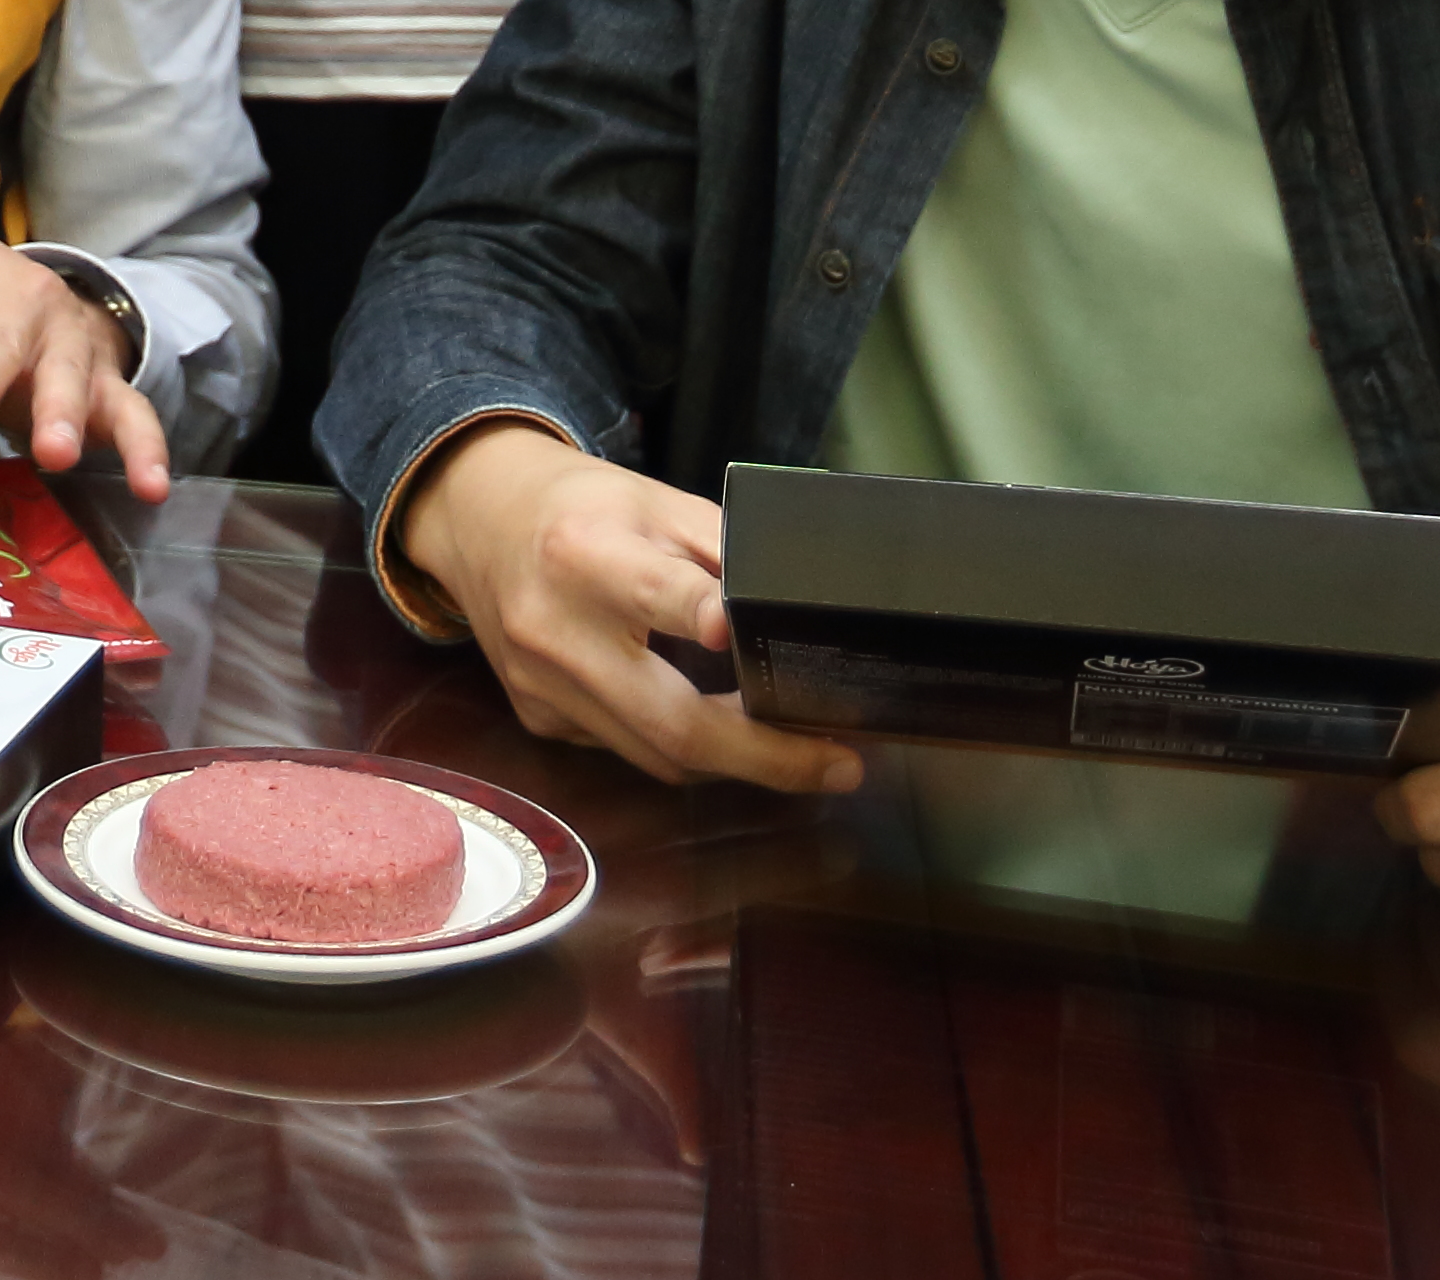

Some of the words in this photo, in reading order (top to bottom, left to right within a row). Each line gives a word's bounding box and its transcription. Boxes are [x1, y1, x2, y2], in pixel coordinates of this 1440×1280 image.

[7, 639, 62, 663] Hoya
[1097, 655, 1189, 675] Hoya
[1083, 683, 1191, 701] Nutrition
